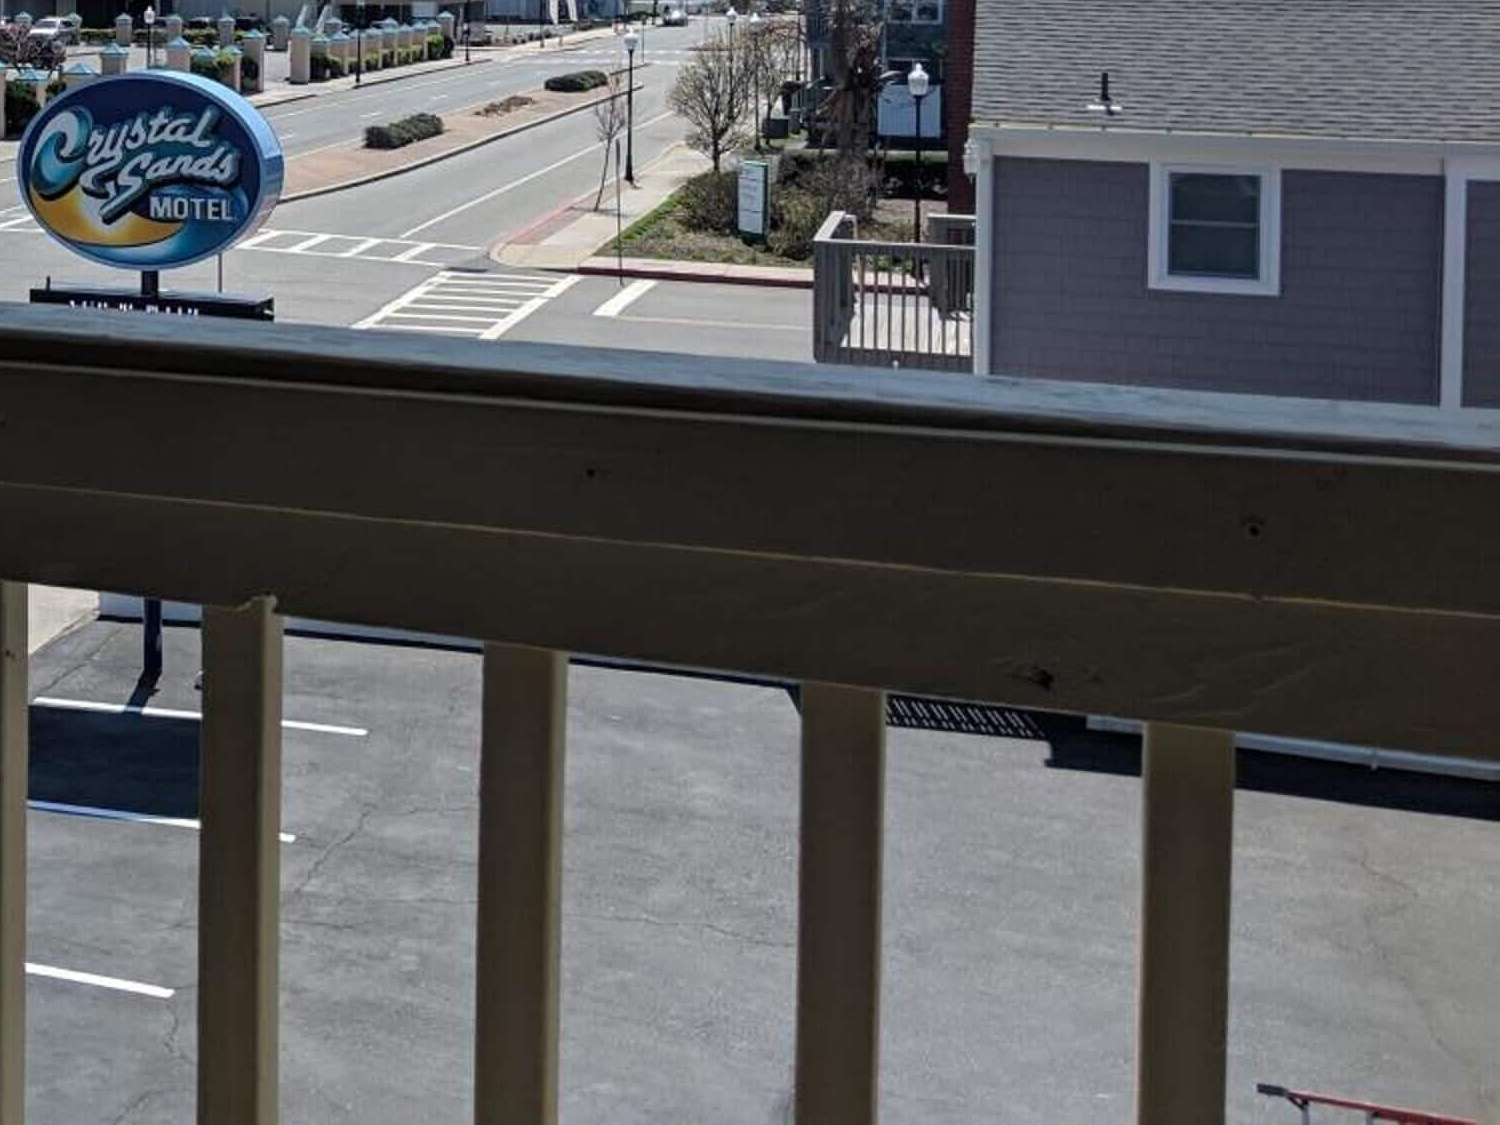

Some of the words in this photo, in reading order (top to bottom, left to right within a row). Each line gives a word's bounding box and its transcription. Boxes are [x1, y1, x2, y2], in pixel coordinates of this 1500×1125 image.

[31, 105, 213, 200] Crystal
[100, 146, 234, 217] Sands
[149, 196, 233, 221] MOTEL
